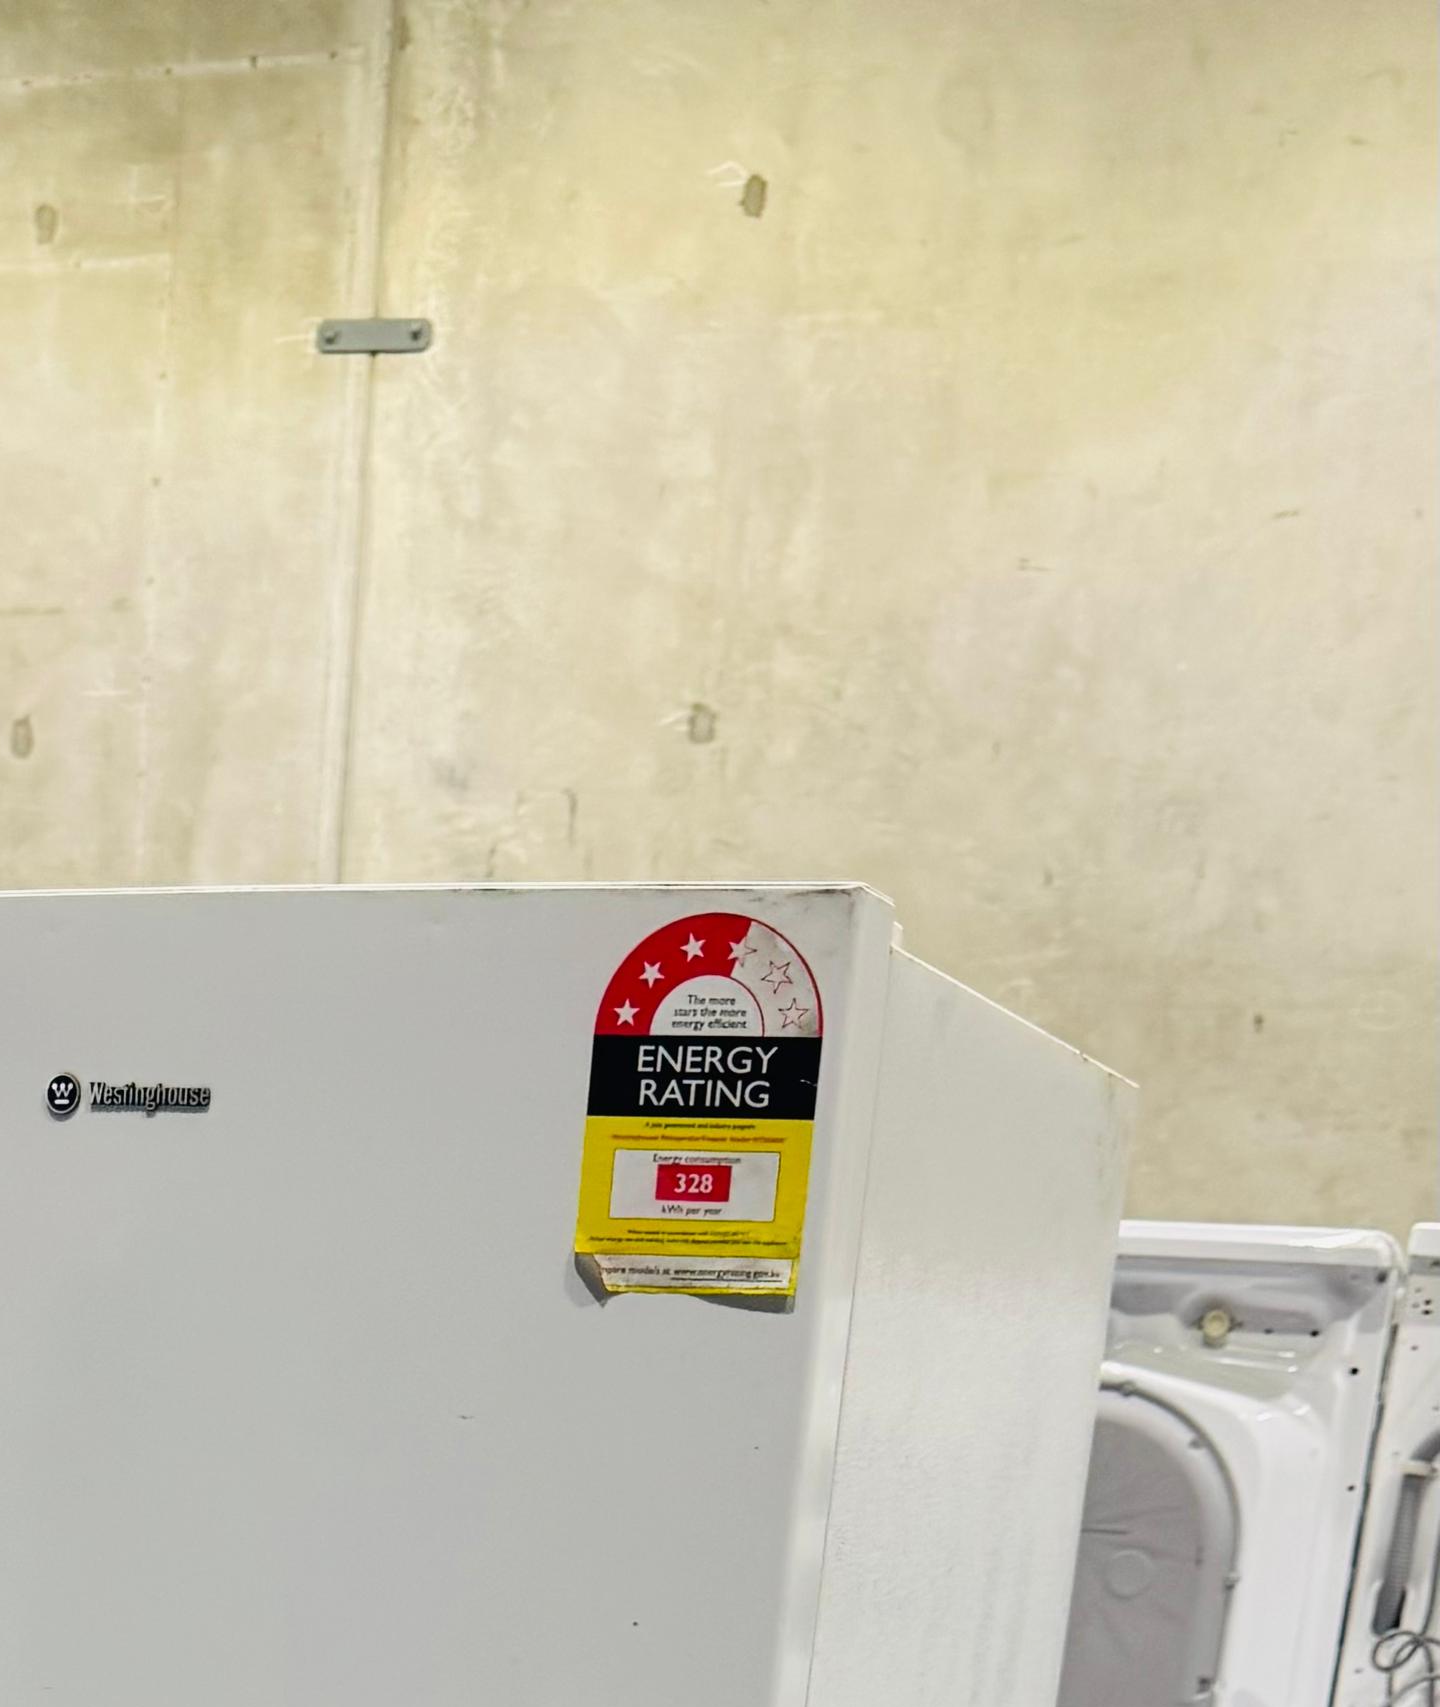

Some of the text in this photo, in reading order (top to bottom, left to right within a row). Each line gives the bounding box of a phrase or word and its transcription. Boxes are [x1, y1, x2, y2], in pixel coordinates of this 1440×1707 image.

[687, 994, 736, 1005] The more
[673, 1007, 747, 1017] stars the more
[671, 1020, 705, 1031] energy
[637, 1045, 779, 1074] ENERGY
[89, 1081, 211, 1112] Westinghouse
[638, 1079, 771, 1108] RATING
[652, 1153, 683, 1165] Energy
[673, 1173, 713, 1193] 328
